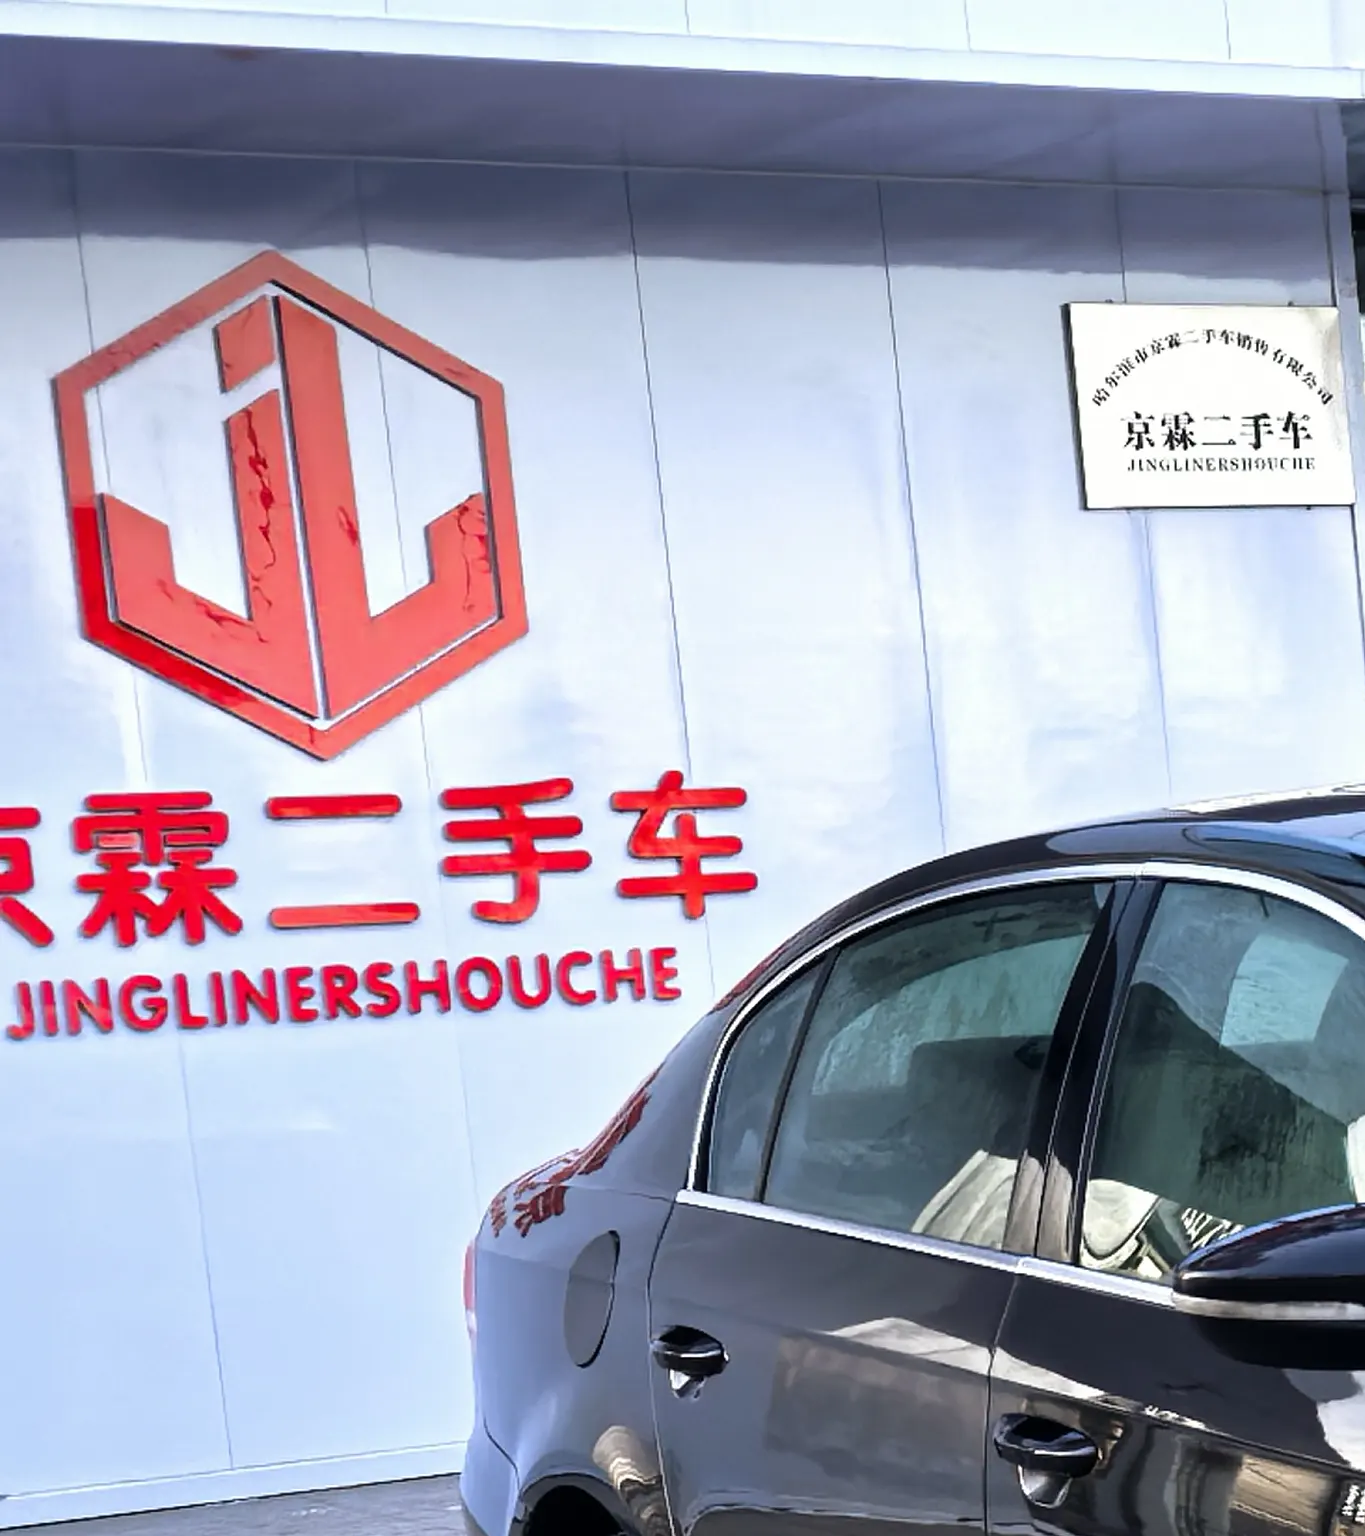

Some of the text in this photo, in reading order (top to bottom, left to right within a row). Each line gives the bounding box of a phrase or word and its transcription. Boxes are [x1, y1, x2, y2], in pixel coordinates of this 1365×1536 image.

[1121, 410, 1313, 451] 京霖二手车
[1127, 457, 1316, 472] JINGLINERSHOUCHE
[6, 945, 683, 1041] JINGLINERSHOUCHE
